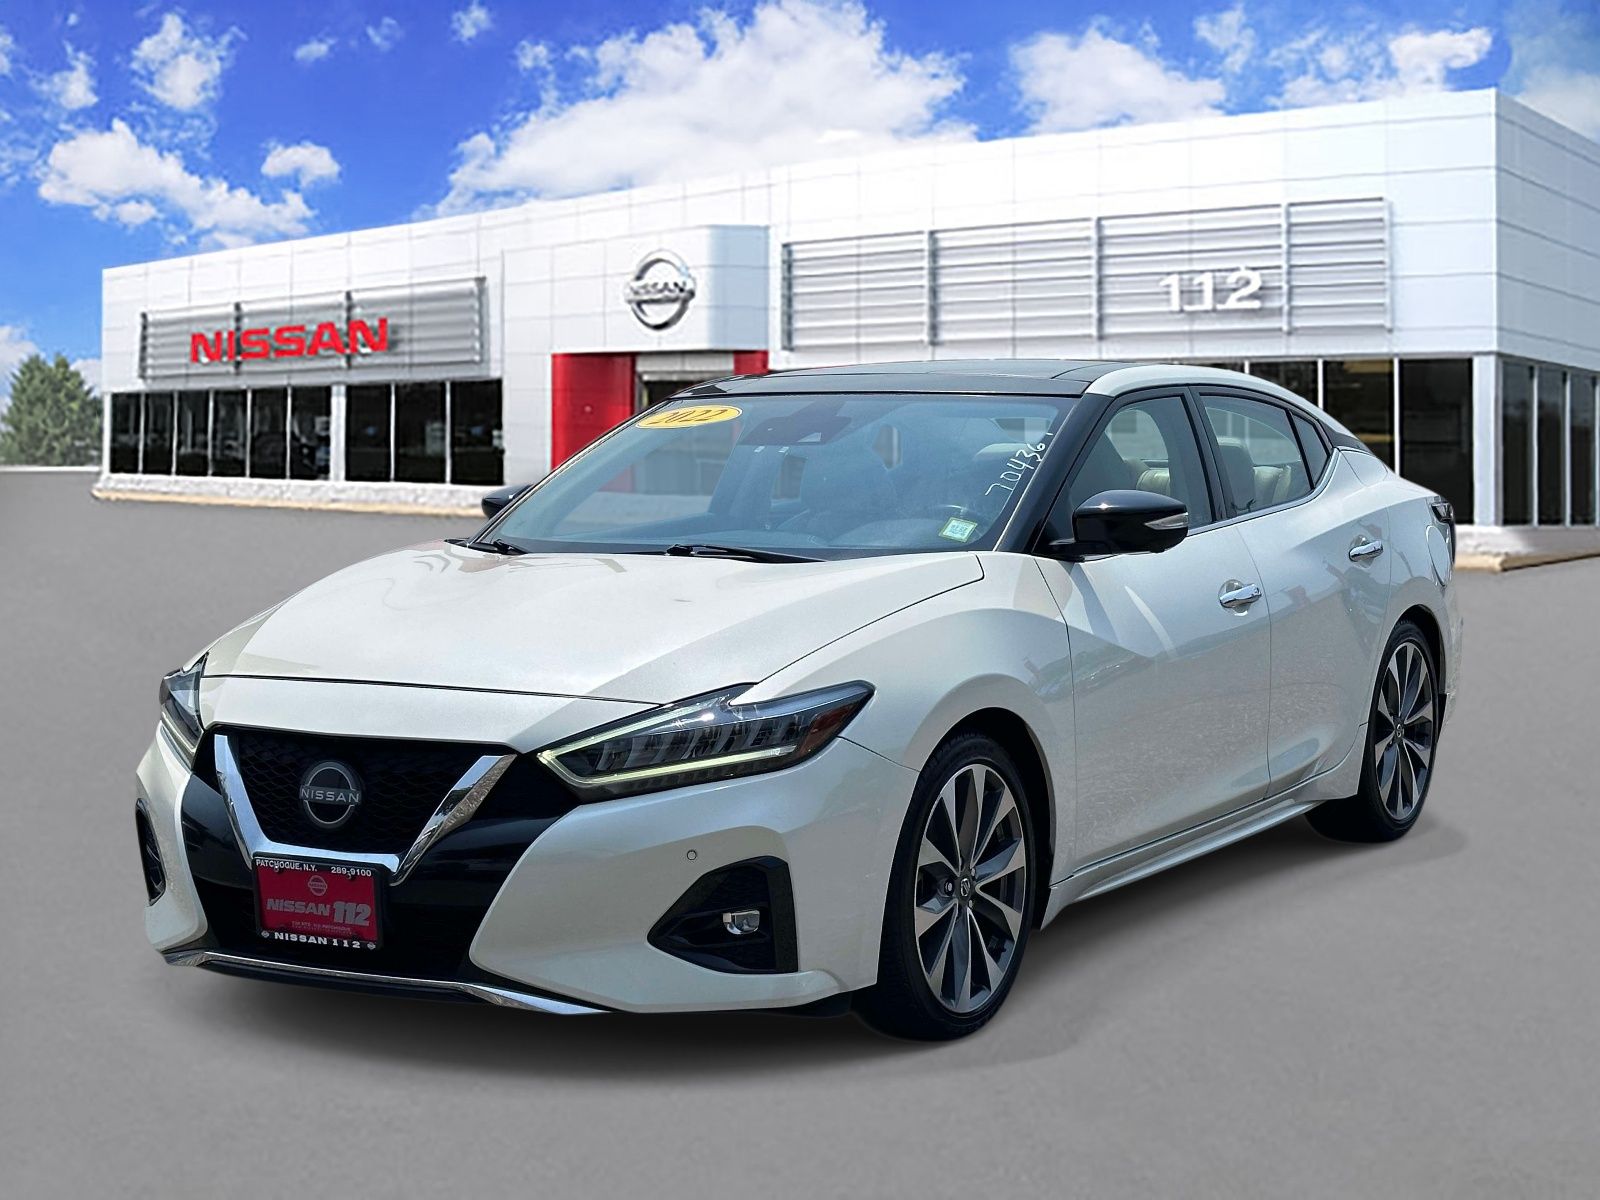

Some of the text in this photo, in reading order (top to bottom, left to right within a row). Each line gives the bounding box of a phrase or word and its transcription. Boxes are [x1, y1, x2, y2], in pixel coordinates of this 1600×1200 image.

[1159, 267, 1262, 311] 112
[190, 316, 389, 363] NISSAN
[645, 408, 729, 426] 2022
[301, 788, 360, 803] NISSAN
[330, 866, 372, 877] 289-9100
[266, 898, 372, 927] NISSAN 112
[274, 932, 328, 945] NISSAN
